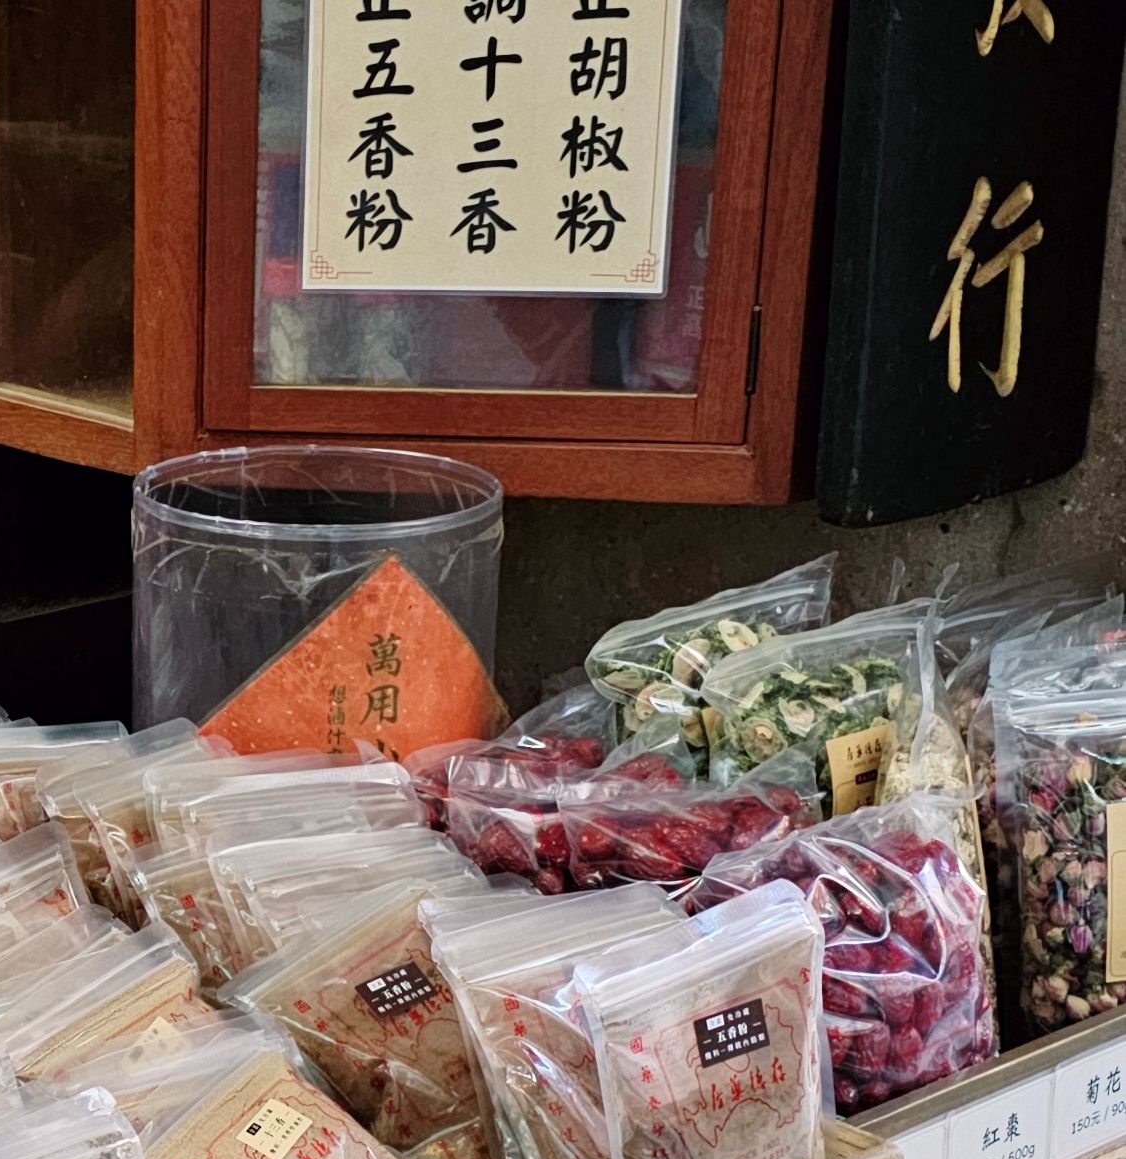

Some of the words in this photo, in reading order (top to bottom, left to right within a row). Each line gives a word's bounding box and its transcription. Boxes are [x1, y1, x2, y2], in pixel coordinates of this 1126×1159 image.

[716, 1021, 748, 1043] 五香粉
[1085, 1066, 1122, 1105] 菊花
[982, 1112, 1020, 1151] 紅棗
[1072, 1111, 1101, 1135] 150元
